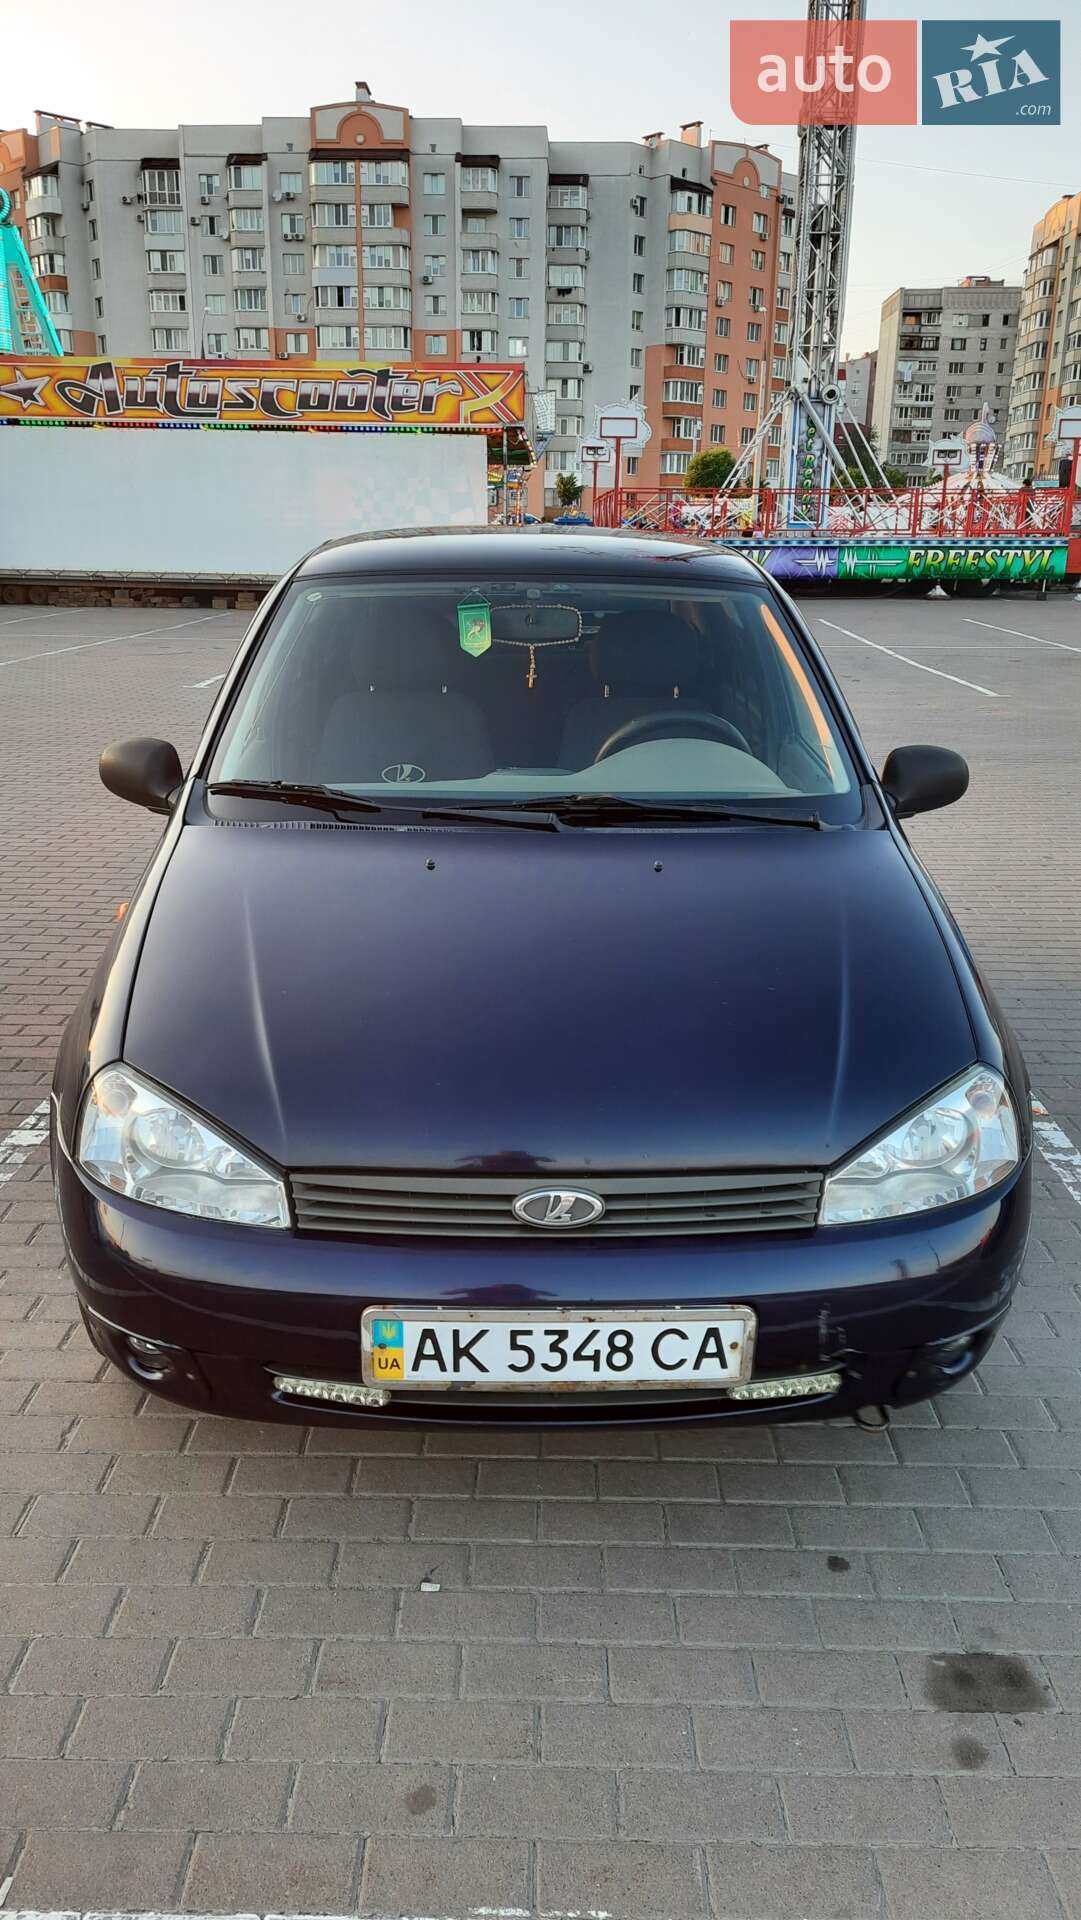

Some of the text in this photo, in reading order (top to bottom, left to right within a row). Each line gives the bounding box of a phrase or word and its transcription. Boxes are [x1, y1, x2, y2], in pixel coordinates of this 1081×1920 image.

[55, 360, 463, 421] Autoscooter
[377, 1358, 401, 1371] UA
[411, 1327, 729, 1373] AK 5348 CA
